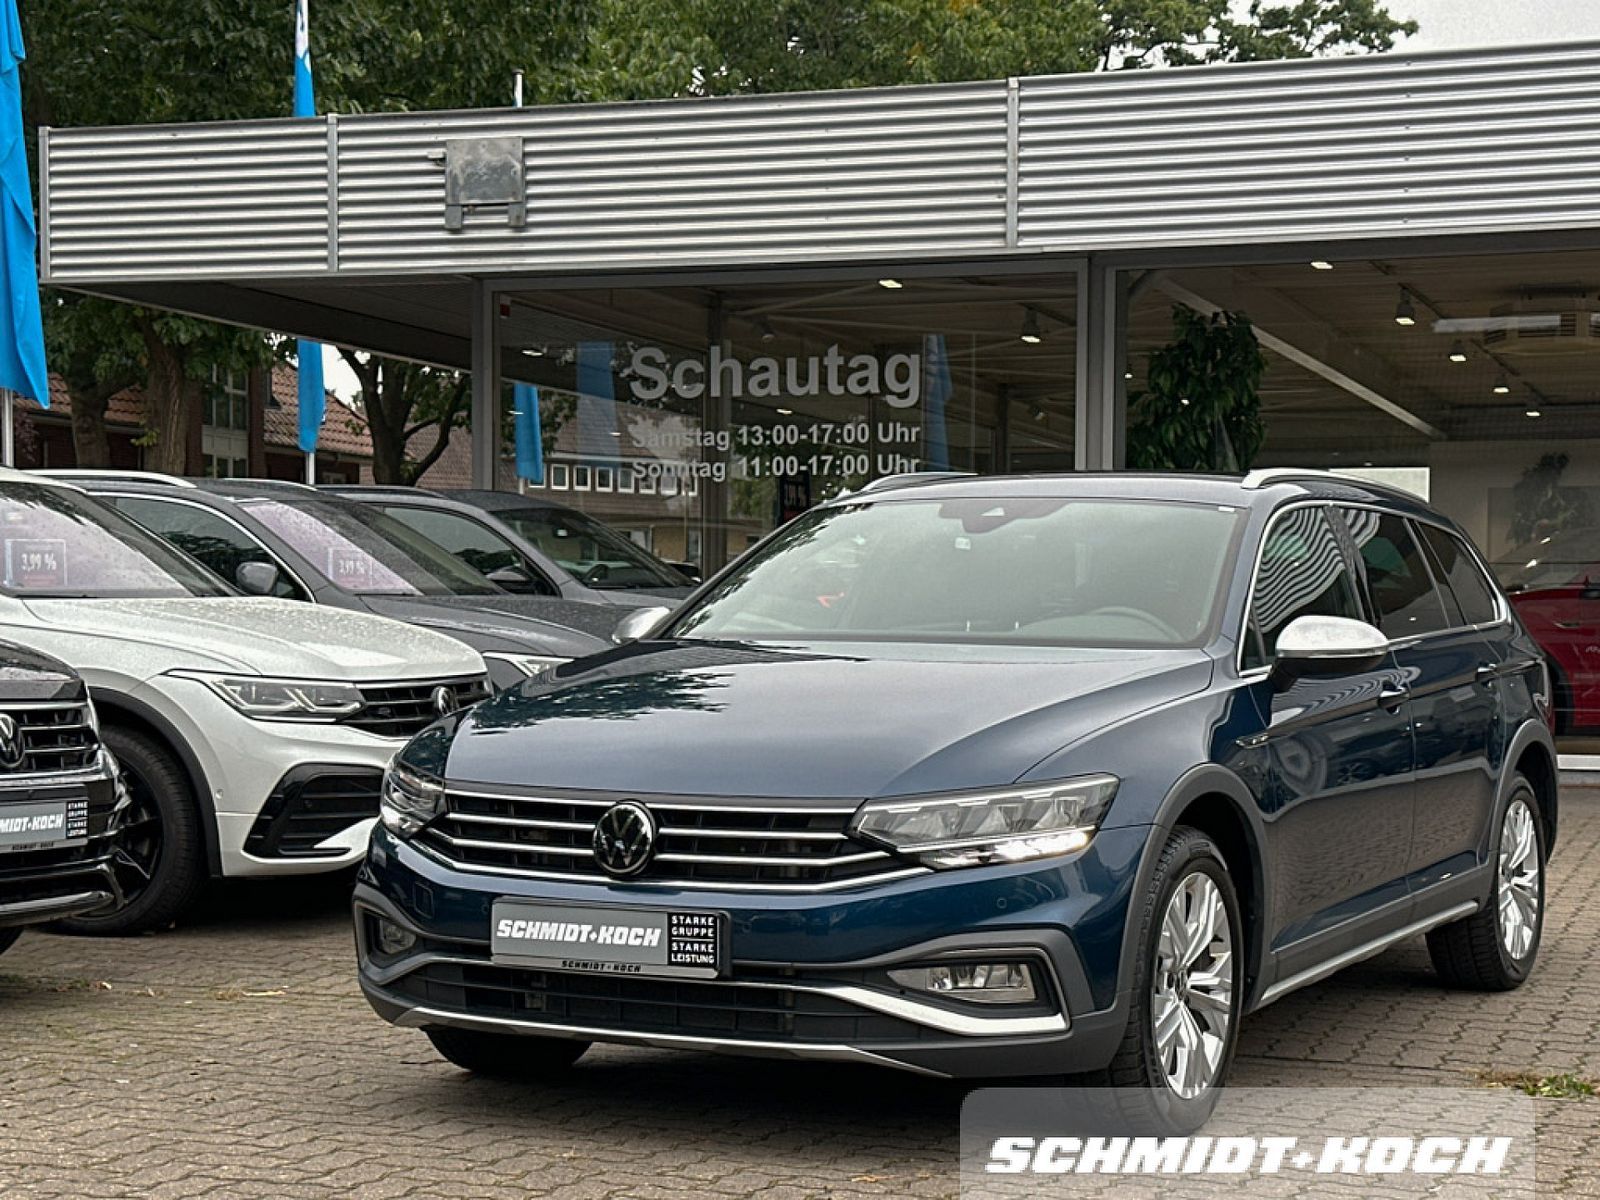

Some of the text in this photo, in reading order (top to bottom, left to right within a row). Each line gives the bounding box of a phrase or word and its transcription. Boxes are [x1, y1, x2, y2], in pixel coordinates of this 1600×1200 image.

[629, 344, 921, 408] Schautag
[631, 422, 921, 451] Samstag 13:00-17:00 Uhr
[632, 453, 921, 482] Sonntag 11:00-17:00 Uhr
[671, 915, 714, 926] STARKE
[671, 926, 714, 937] GRUPPE
[671, 941, 714, 953] STARKE
[671, 952, 714, 964] LEISTUNG
